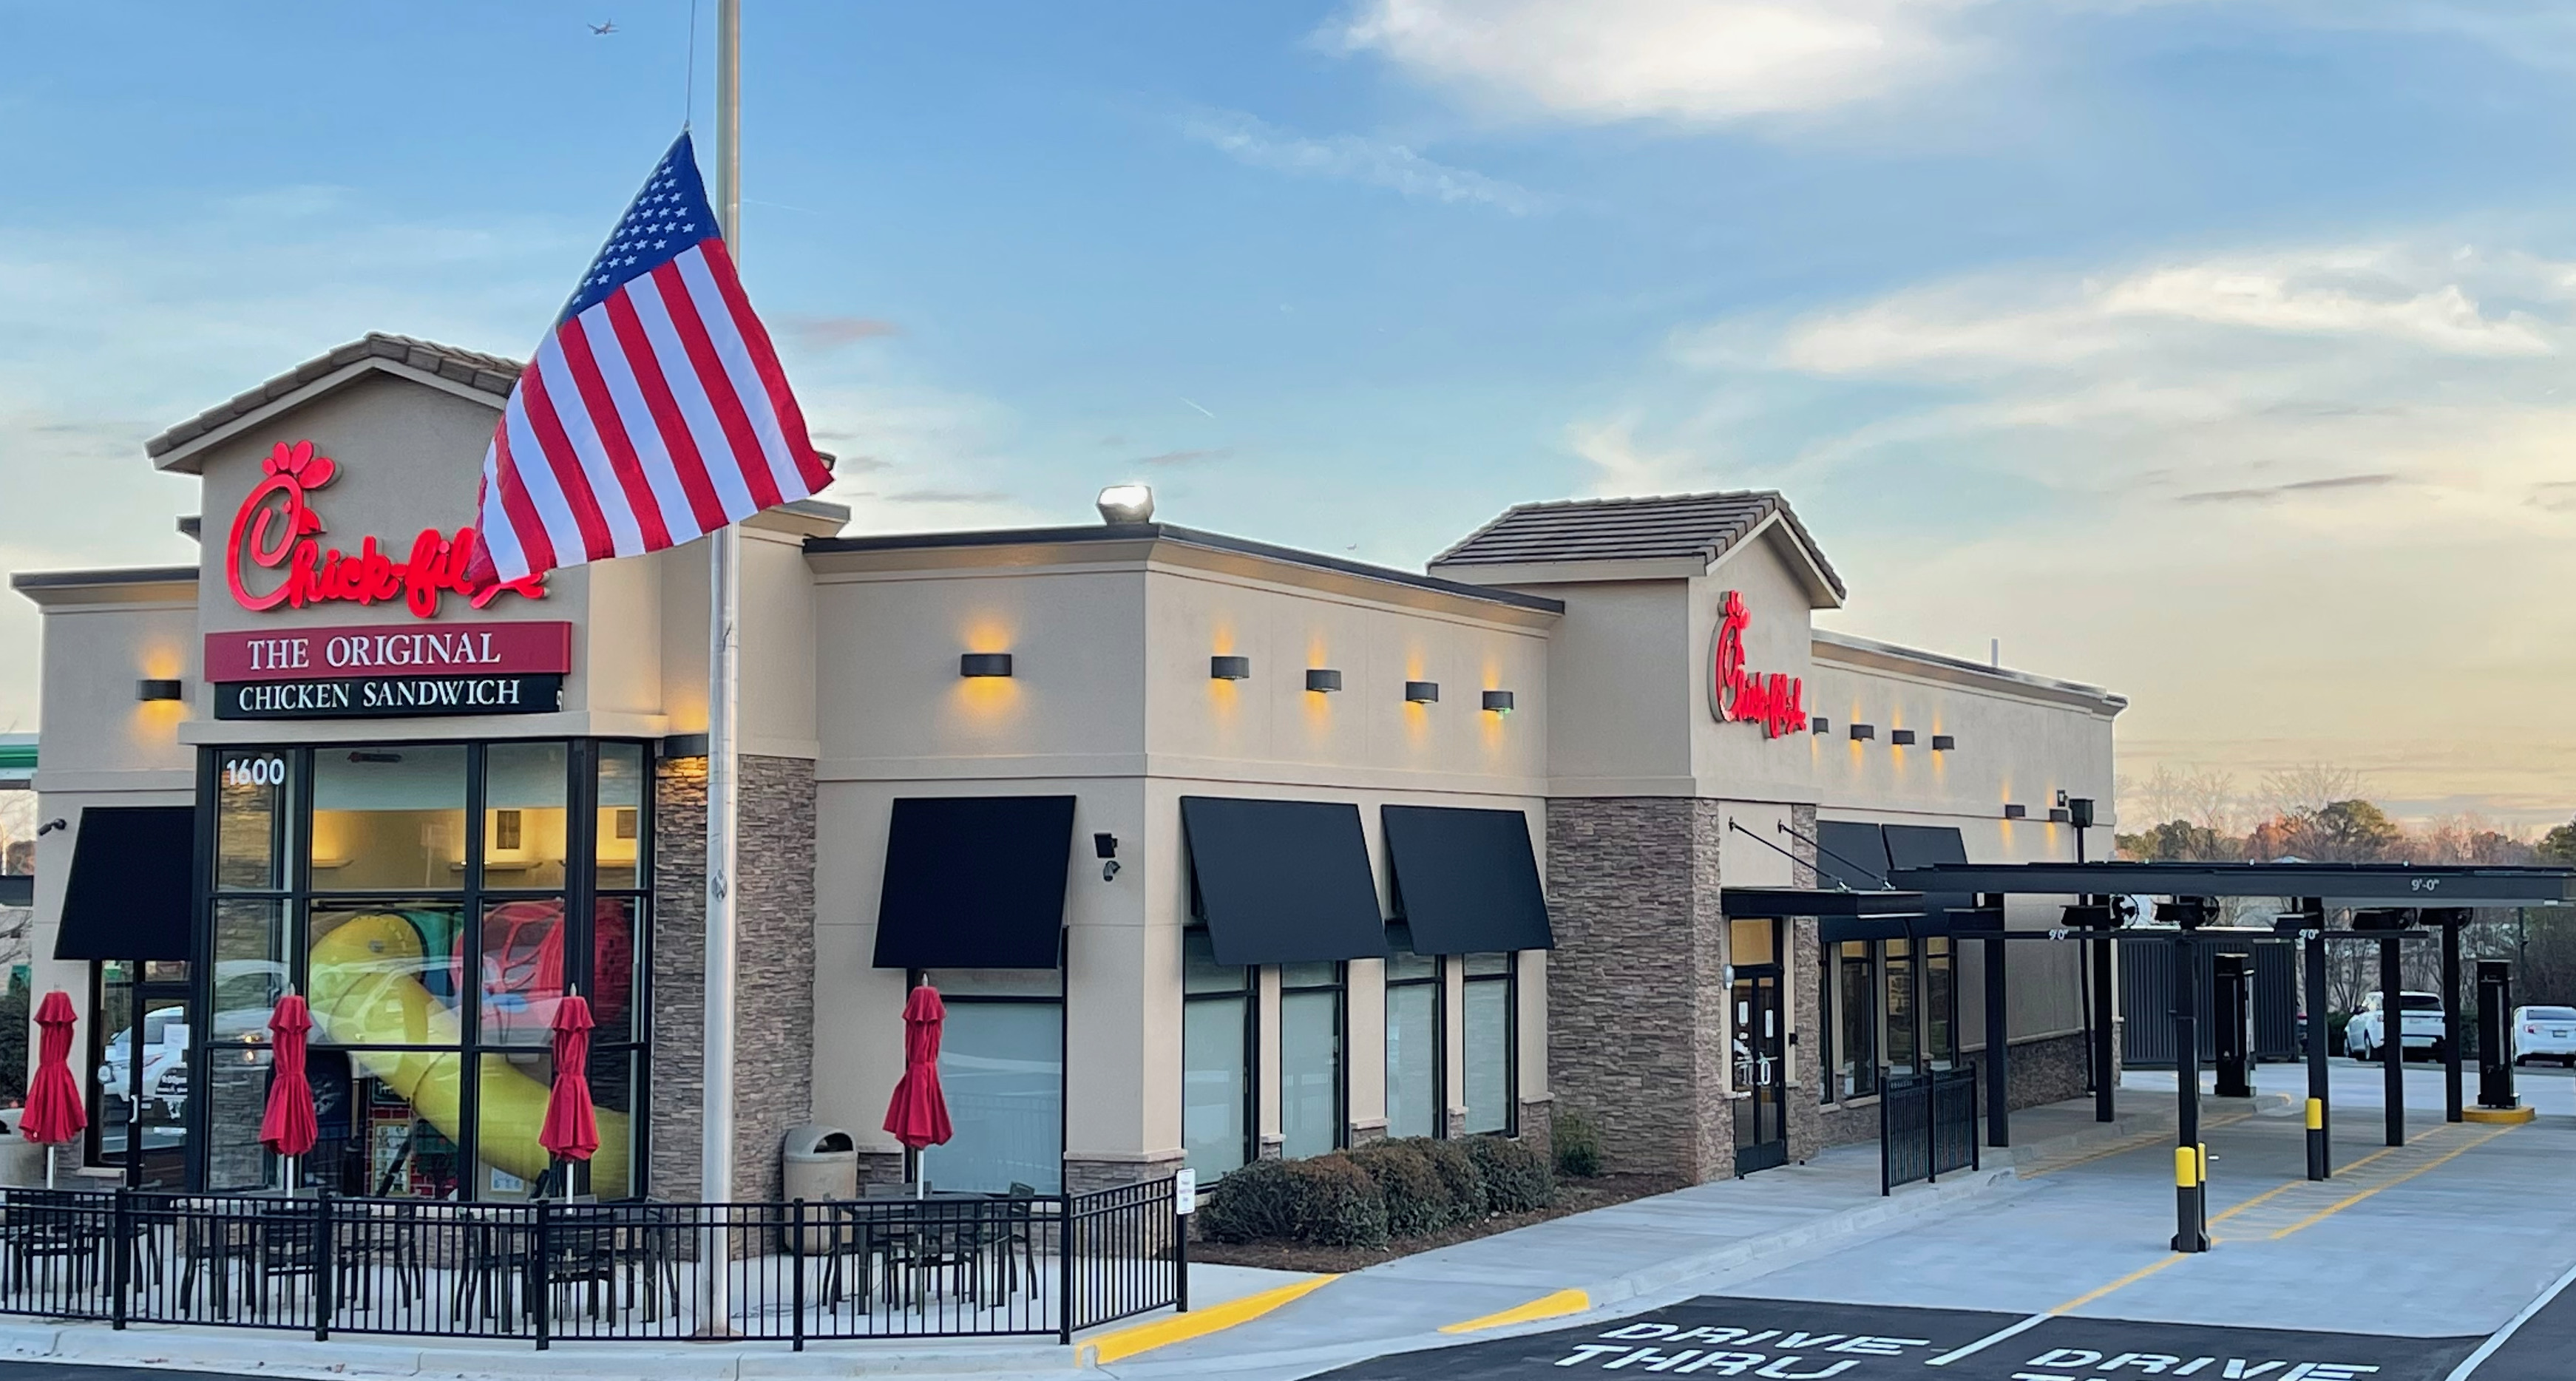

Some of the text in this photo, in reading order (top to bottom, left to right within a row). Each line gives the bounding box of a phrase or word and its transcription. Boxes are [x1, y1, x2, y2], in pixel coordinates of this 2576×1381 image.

[226, 441, 551, 620] Chick-fil
[247, 632, 501, 671] THE ORIGINAL
[238, 679, 520, 711] CHICKEN SANDWICH
[226, 758, 285, 786] 1600
[2411, 878, 2440, 892] 9'-0"
[1598, 1323, 1931, 1354] DRIVE
[1554, 1343, 1861, 1380] THRU
[2025, 1348, 2381, 1381] DRIVE
